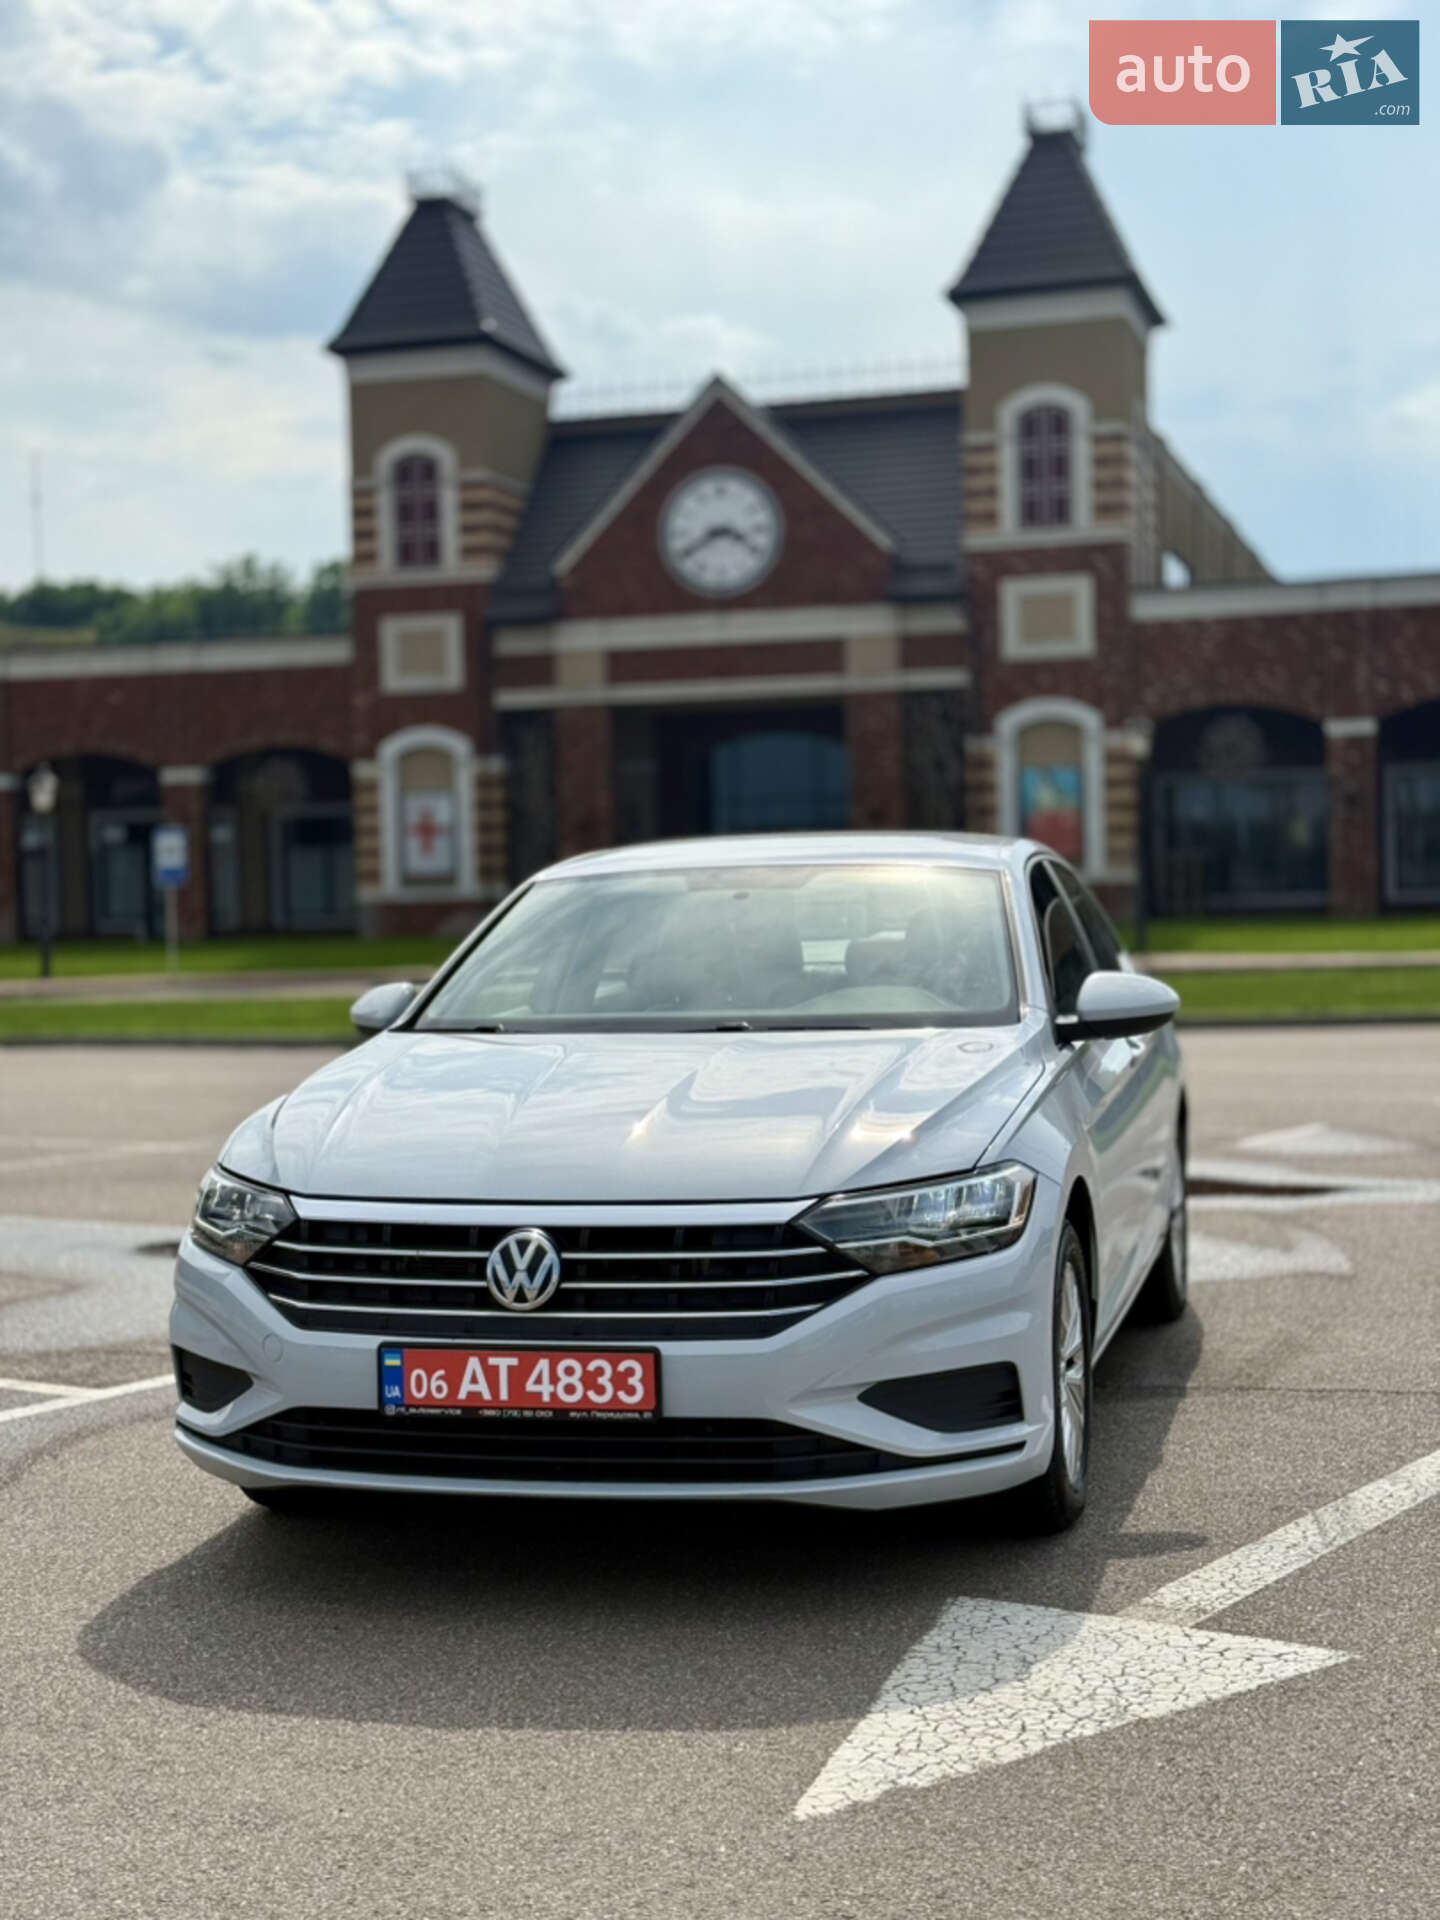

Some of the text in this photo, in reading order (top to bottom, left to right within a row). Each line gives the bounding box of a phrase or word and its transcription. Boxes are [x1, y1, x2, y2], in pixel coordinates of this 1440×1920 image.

[384, 1385, 401, 1399] UA
[409, 1356, 645, 1405] 06 AT 4833
